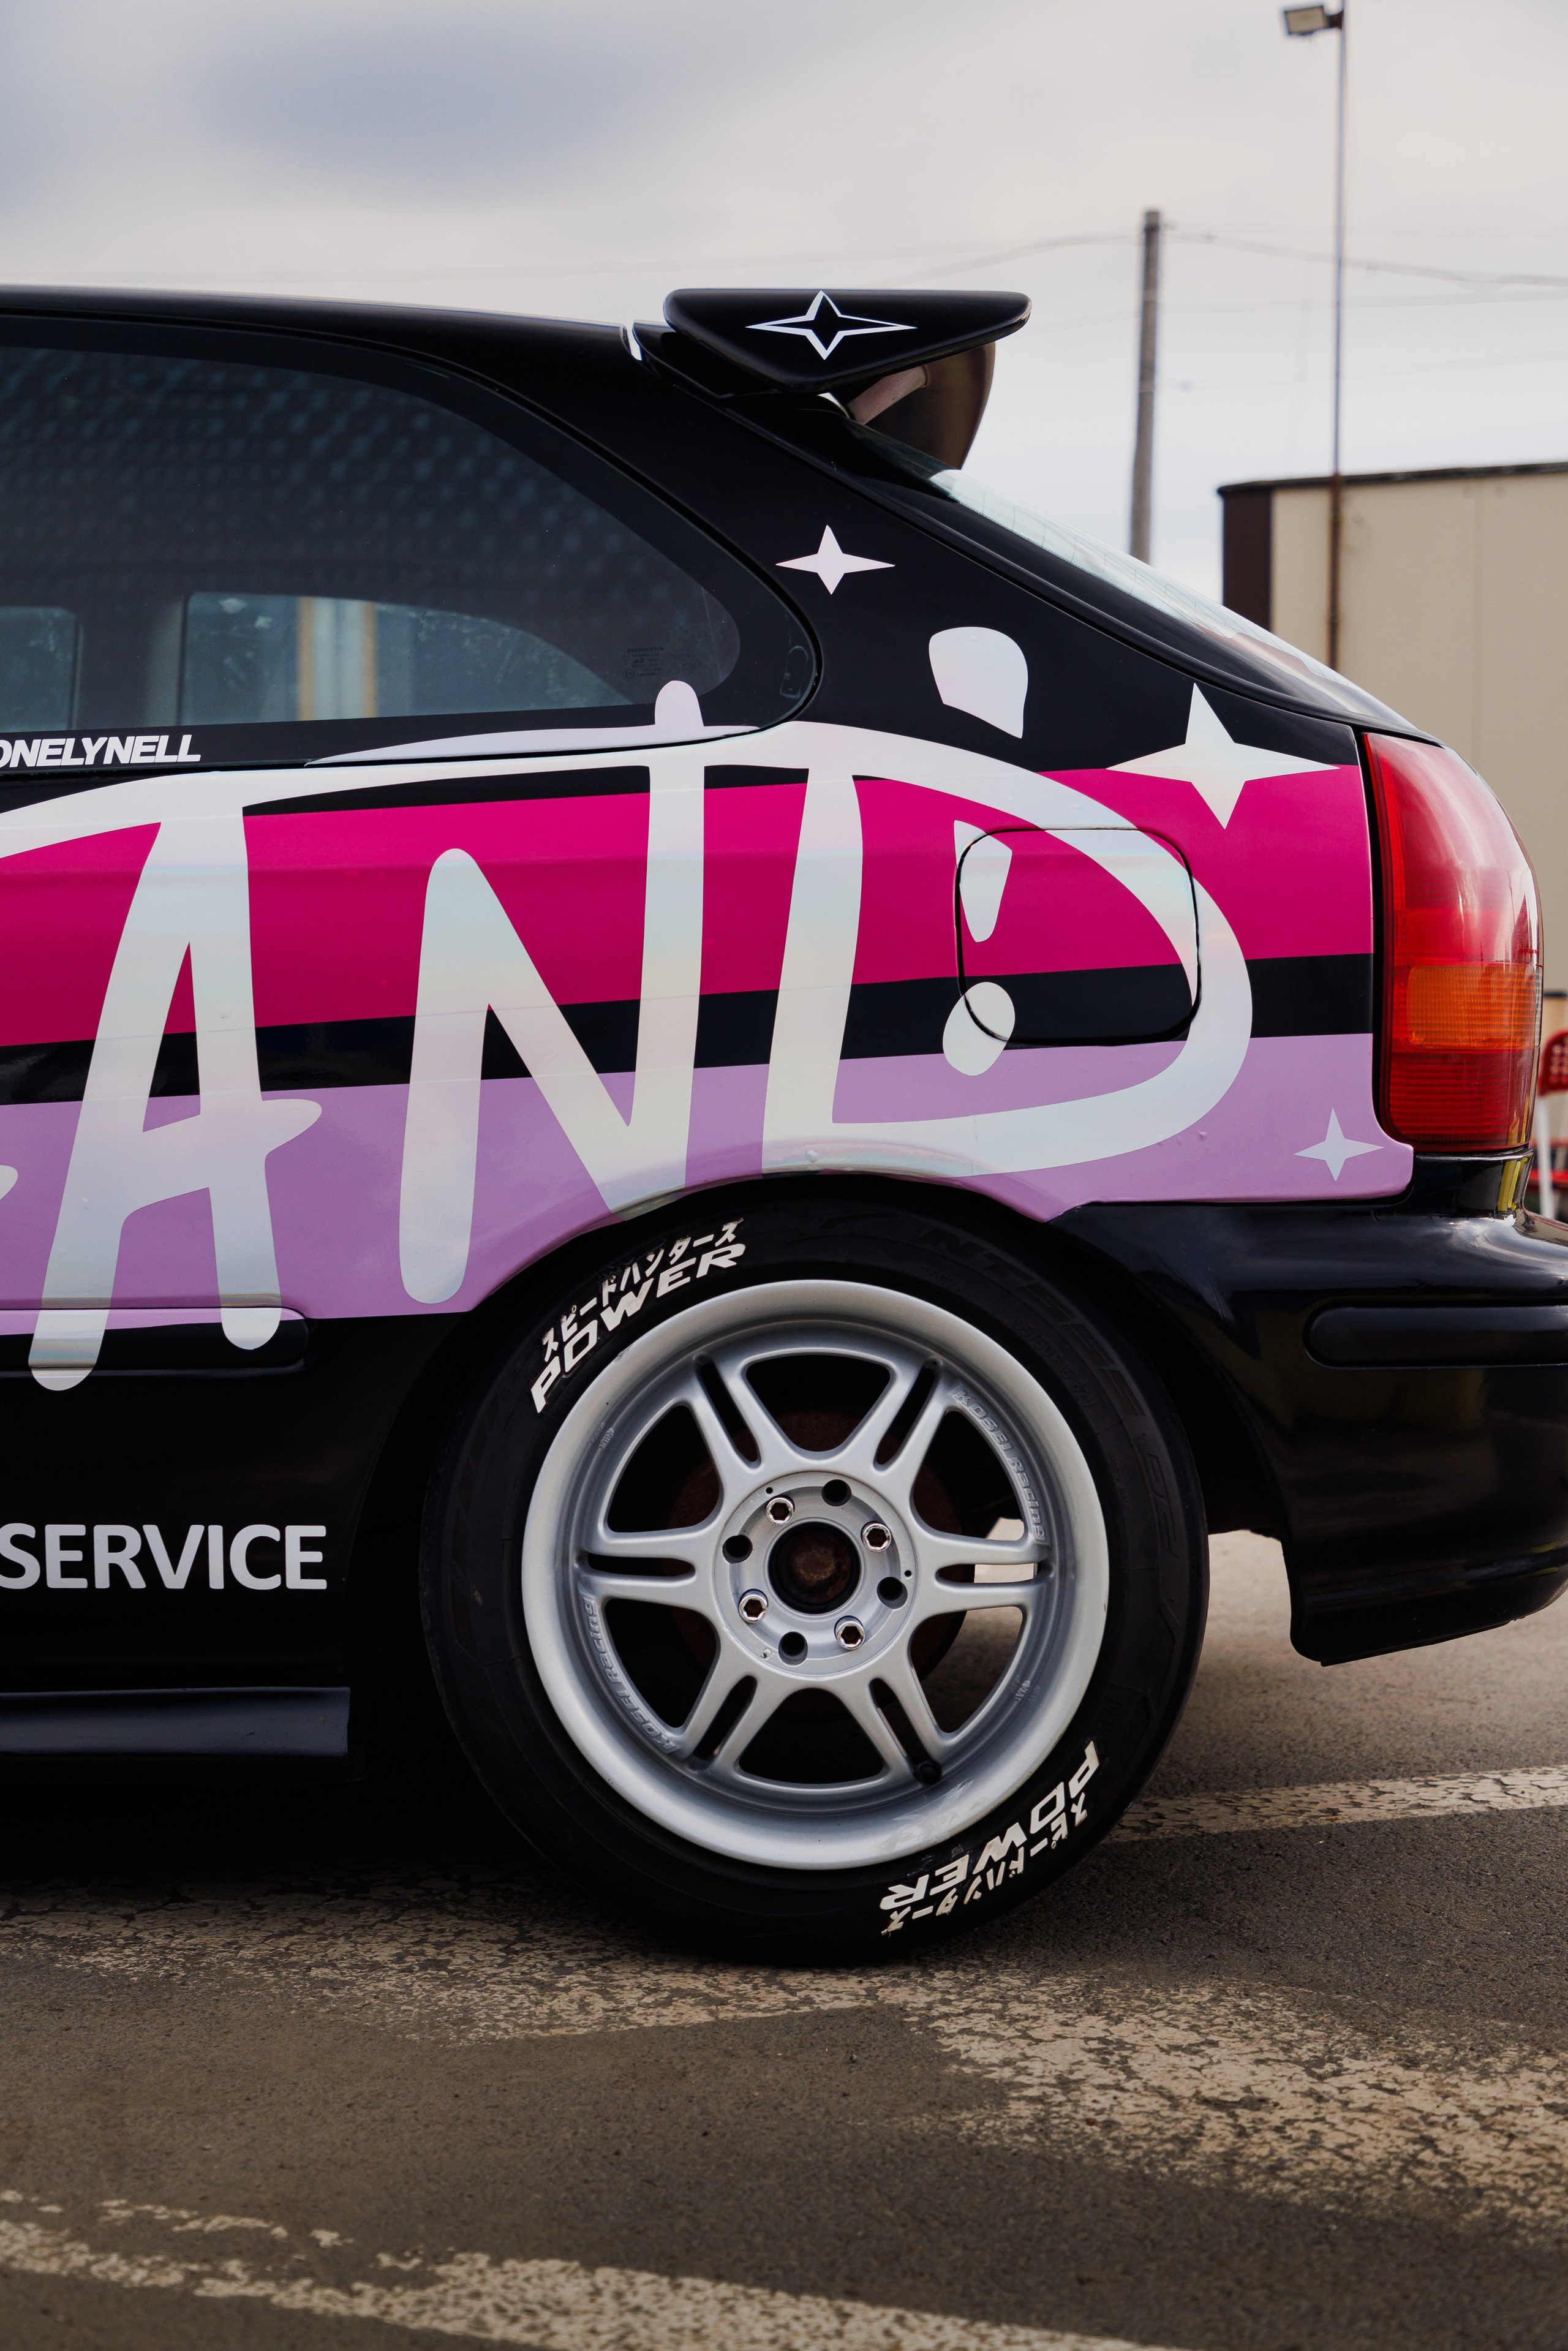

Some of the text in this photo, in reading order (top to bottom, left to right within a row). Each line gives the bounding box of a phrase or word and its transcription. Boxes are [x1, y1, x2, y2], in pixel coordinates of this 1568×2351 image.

[530, 1243, 746, 1413] POWER
[952, 1387, 1012, 1452] KOSEI
[0, 1523, 328, 1590] SERVICE
[880, 1740, 1100, 1911] POWER
